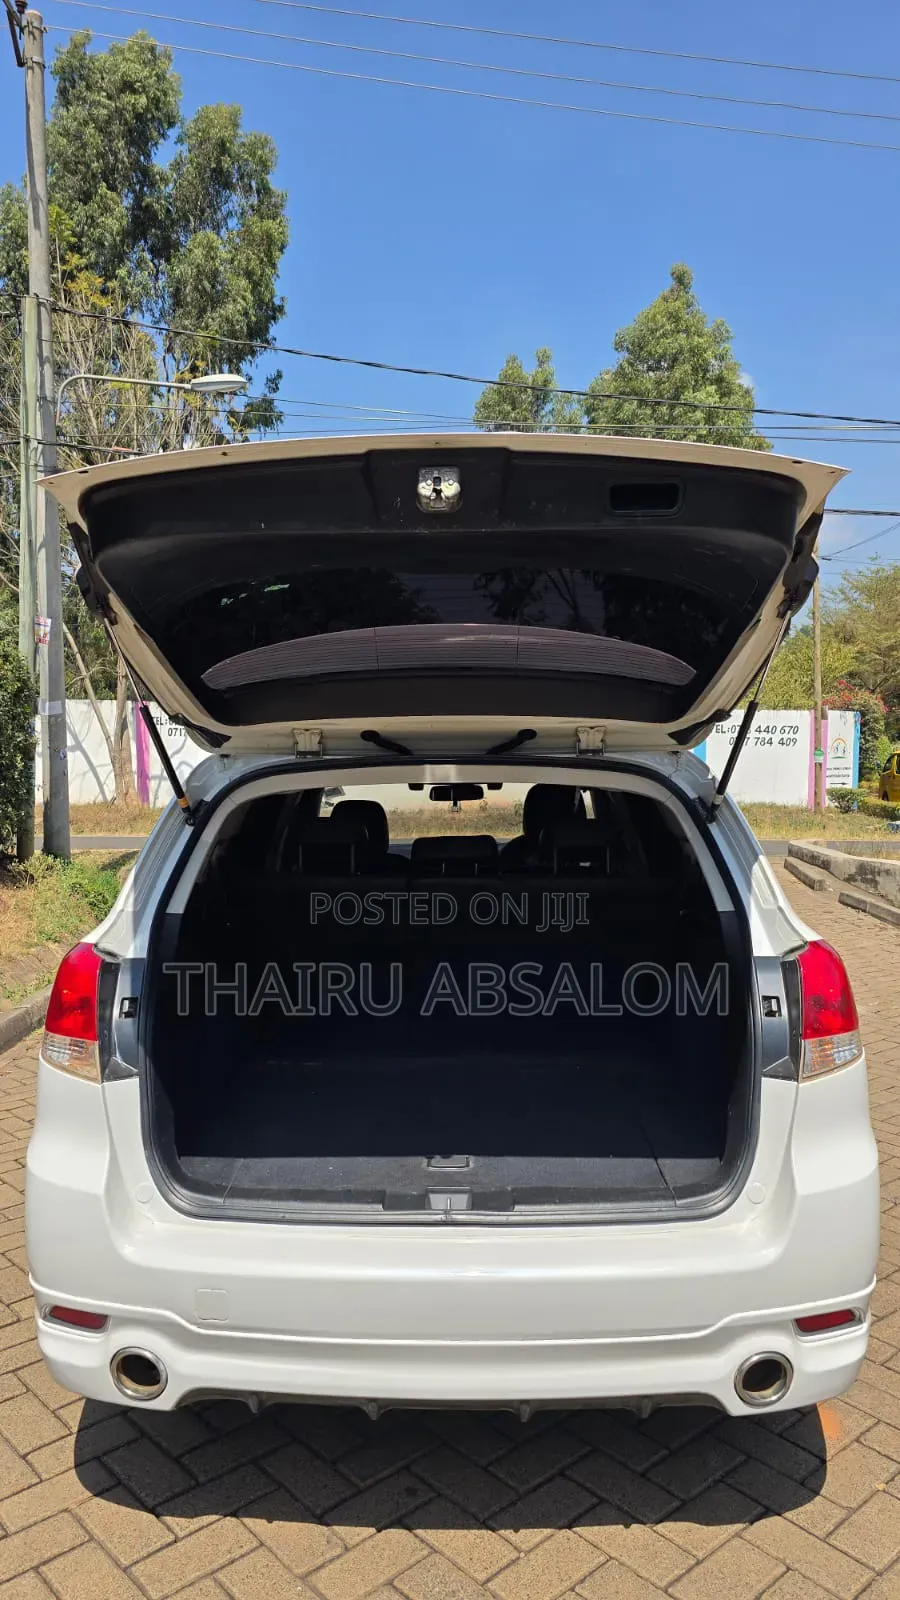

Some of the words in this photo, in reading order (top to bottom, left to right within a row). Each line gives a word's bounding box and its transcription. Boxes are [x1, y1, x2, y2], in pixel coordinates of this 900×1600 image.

[754, 725, 777, 735] 440
[779, 725, 799, 735] 670
[754, 737, 774, 747] 784
[778, 737, 798, 747] 409
